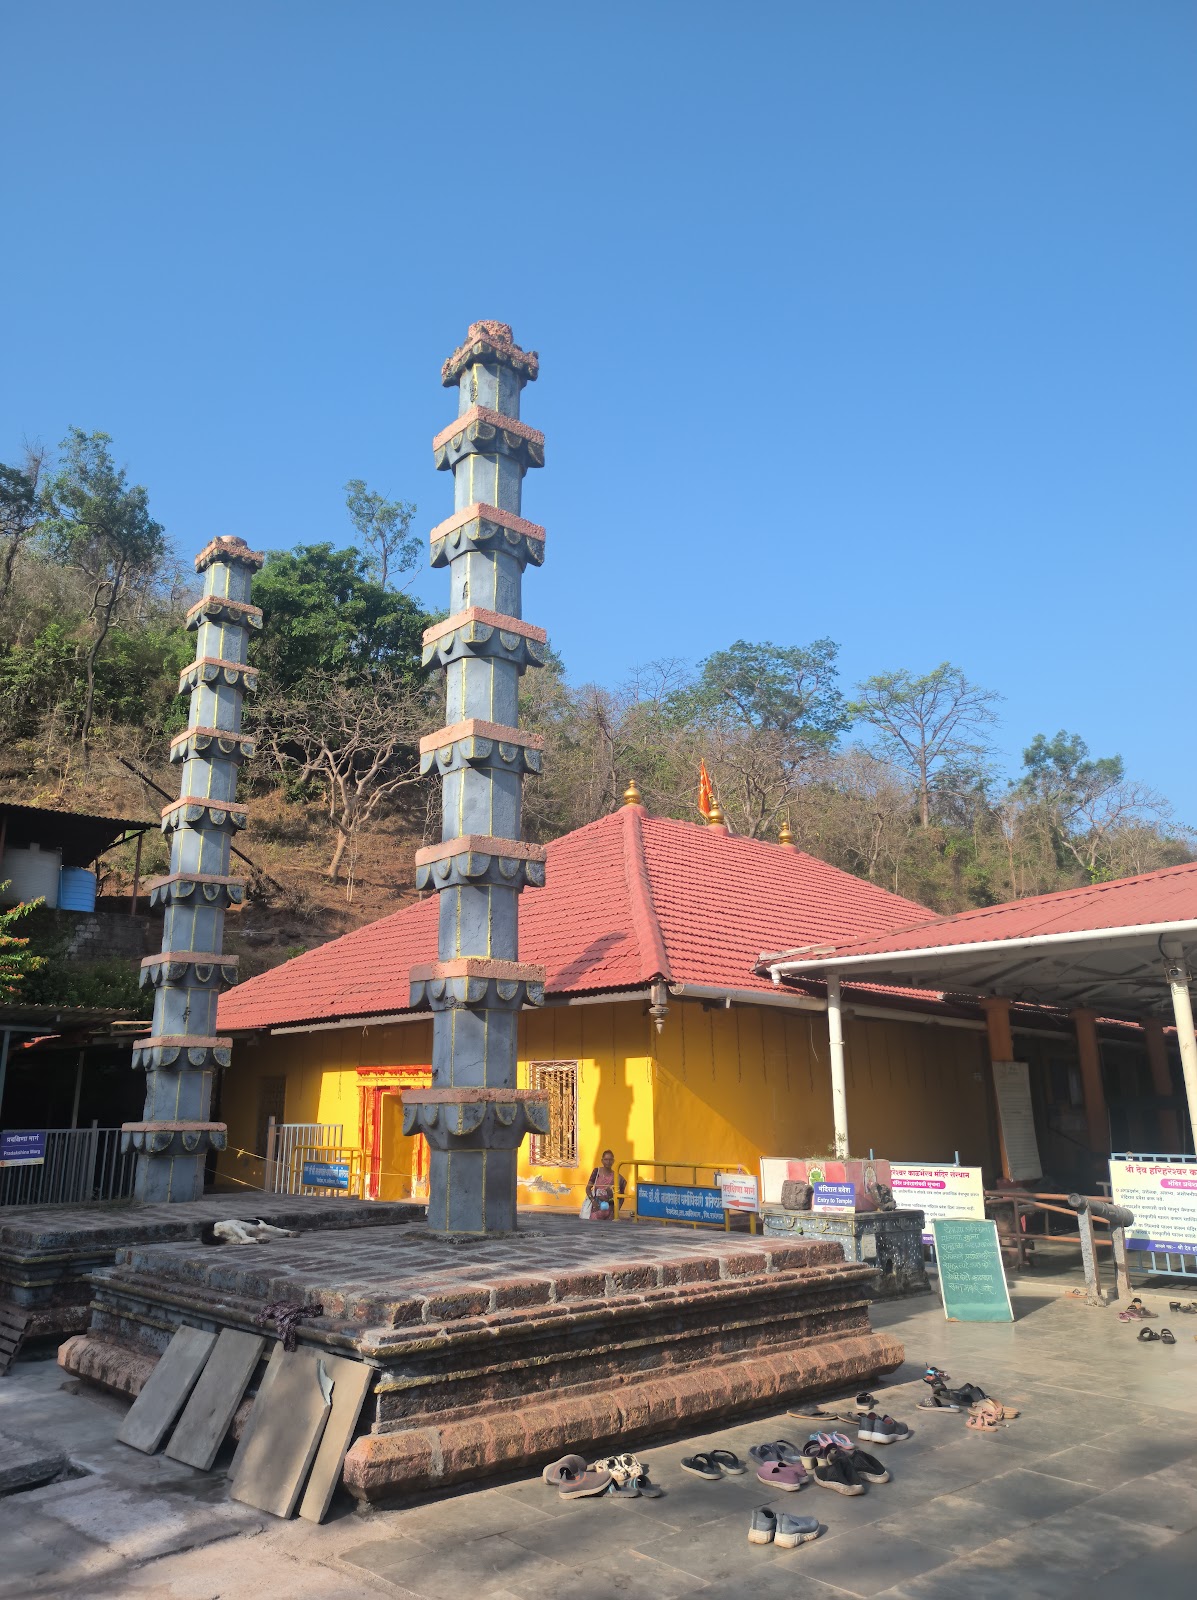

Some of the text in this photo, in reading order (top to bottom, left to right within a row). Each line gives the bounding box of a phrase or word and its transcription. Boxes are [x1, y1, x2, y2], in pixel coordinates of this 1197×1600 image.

[29, 1134, 39, 1142] मार्ग
[889, 1167, 970, 1179] रेश्वर काळभैरव मंदिर संस्थान
[1125, 1165, 1134, 1173] श्री
[1136, 1165, 1147, 1175] देव
[1149, 1166, 1187, 1176] हरिहरेश्वर
[723, 1182, 755, 1195] प्रदक्षिणा मार्ग
[818, 1185, 851, 1193] मंदिरात प्रवेश
